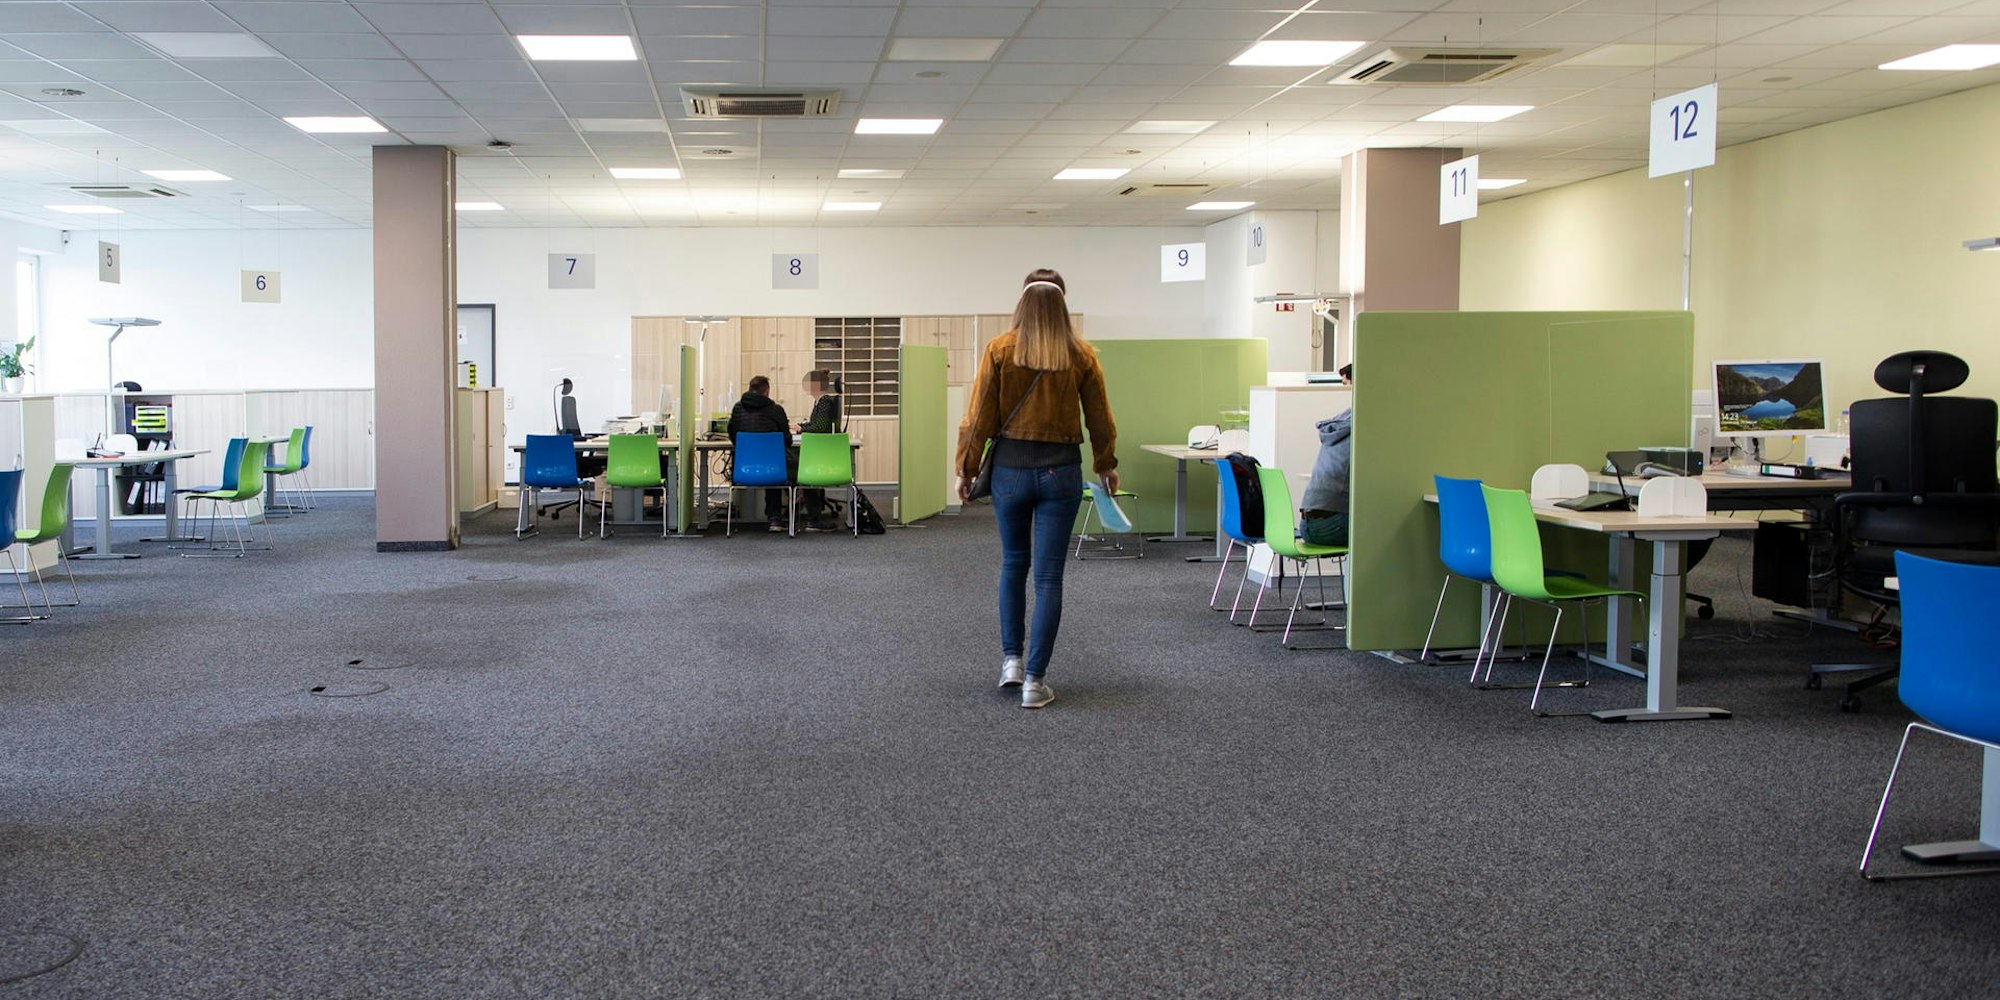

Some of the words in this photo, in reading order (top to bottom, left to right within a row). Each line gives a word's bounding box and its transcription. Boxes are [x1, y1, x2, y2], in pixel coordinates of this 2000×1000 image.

[1669, 100, 1699, 142] 12
[1451, 167, 1468, 198] 11
[1252, 226, 1263, 248] 10
[106, 248, 113, 267] 5
[565, 257, 577, 276] 7
[789, 258, 802, 276] 8
[1177, 248, 1190, 268] 9
[255, 274, 267, 291] 6
